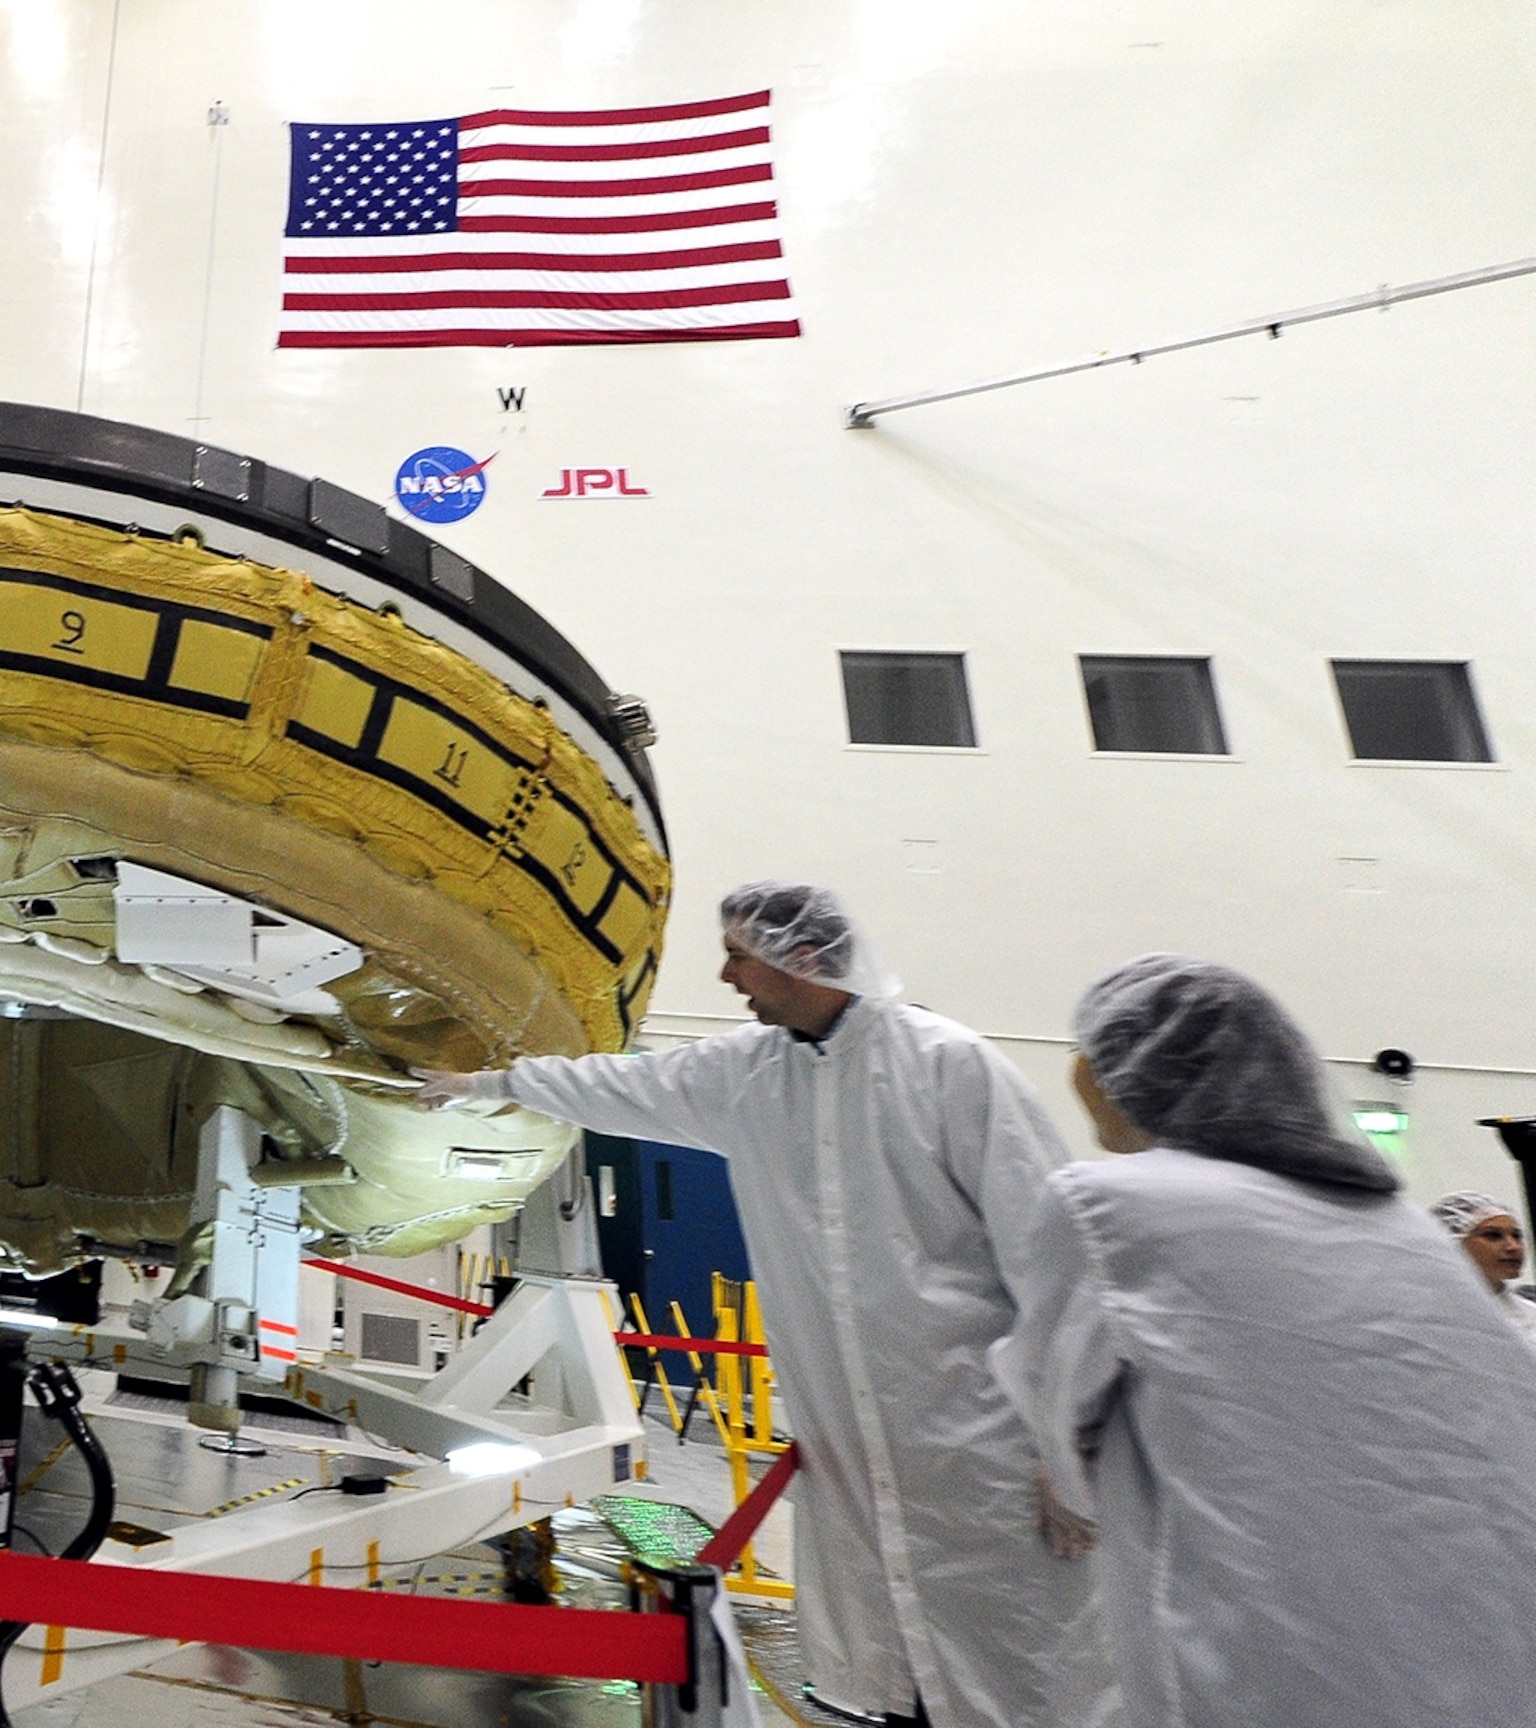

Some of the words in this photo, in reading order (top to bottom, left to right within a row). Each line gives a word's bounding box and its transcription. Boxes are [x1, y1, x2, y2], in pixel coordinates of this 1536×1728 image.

[496, 386, 527, 412] W
[399, 475, 484, 494] NASA
[540, 468, 651, 497] JPL
[59, 610, 86, 646] 9
[437, 741, 470, 783] 11
